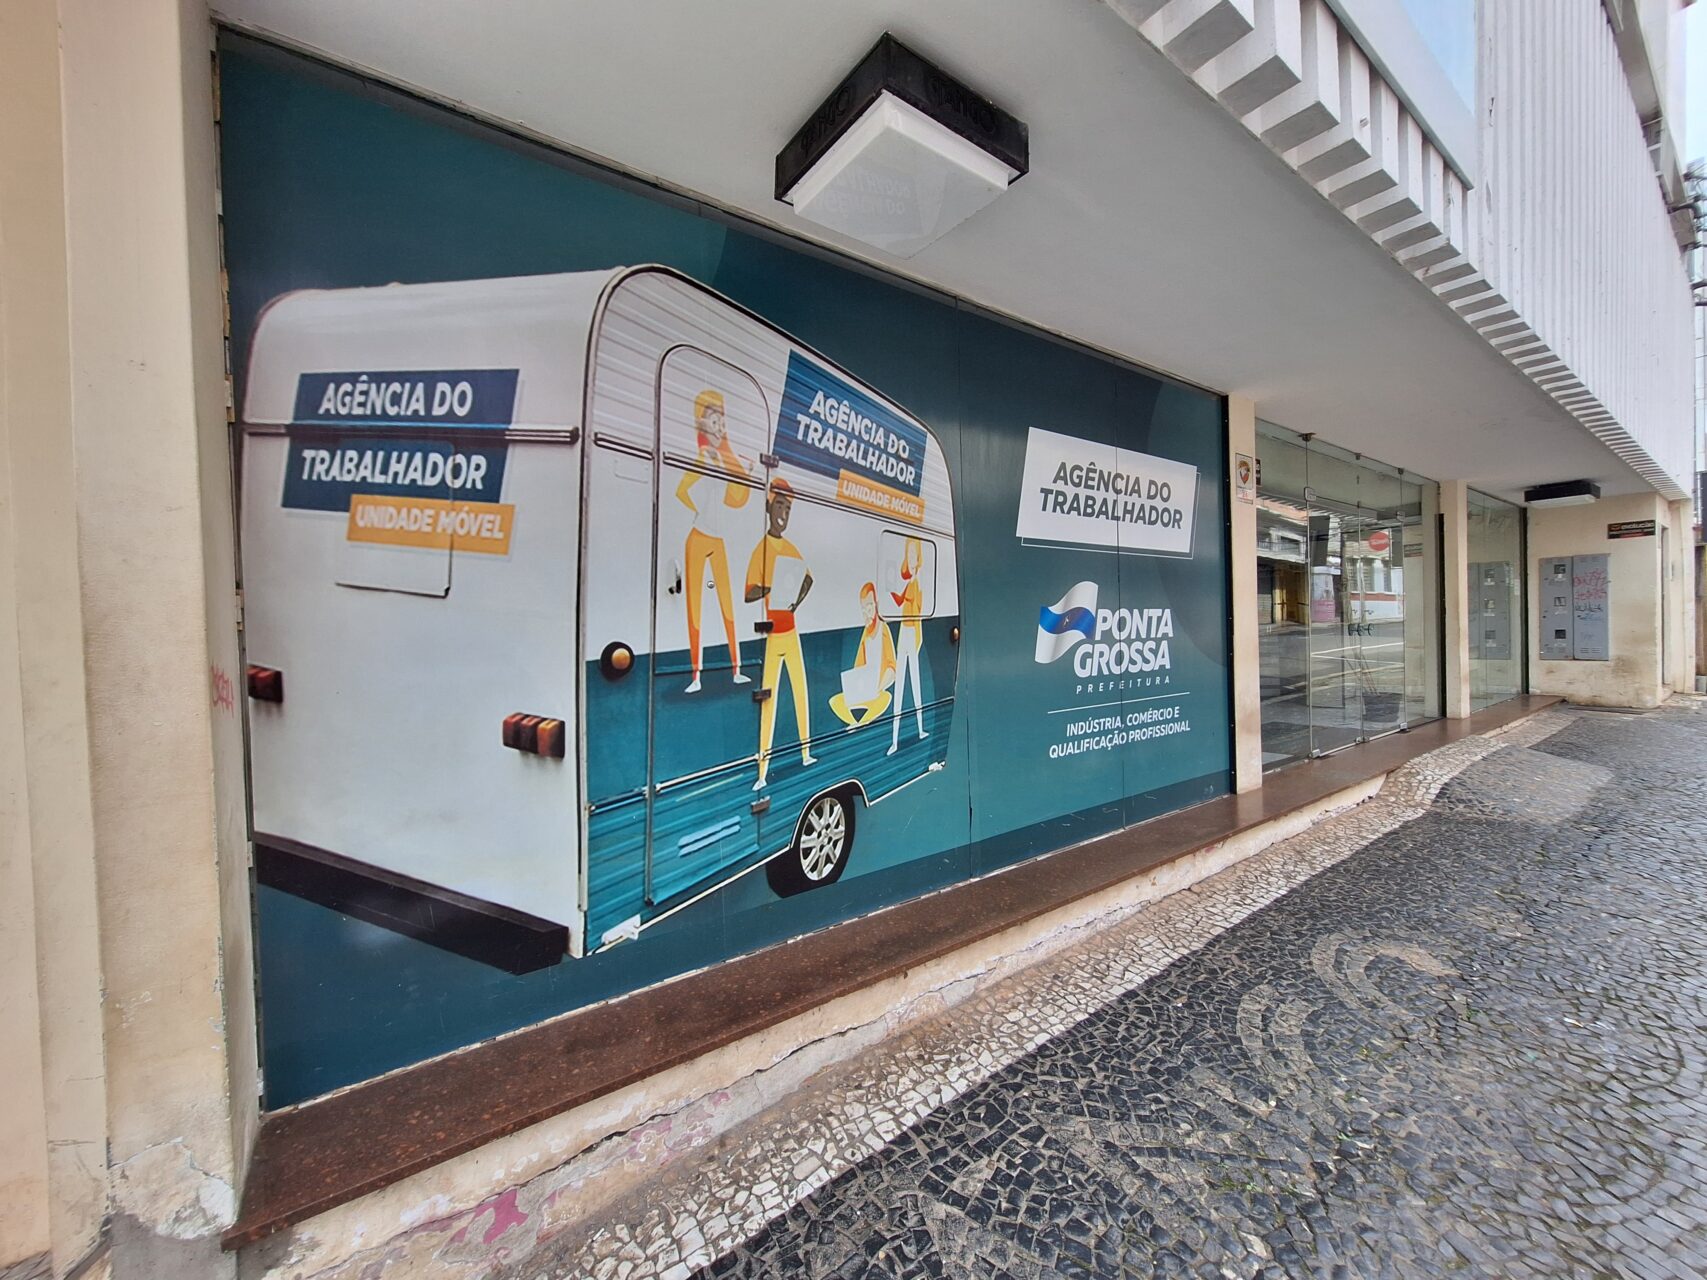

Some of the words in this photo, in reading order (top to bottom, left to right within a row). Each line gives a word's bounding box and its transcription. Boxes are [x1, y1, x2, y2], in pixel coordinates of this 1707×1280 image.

[318, 375, 426, 416] AGÊNCIA
[432, 381, 473, 416] DO
[809, 390, 885, 449] AGÊNCIA
[888, 433, 909, 459] DO
[797, 413, 915, 486] TRABALHADOR
[301, 450, 487, 490] TRABALHADOR
[1053, 461, 1142, 498] AGÊNCIA
[1147, 480, 1171, 503] DO
[843, 480, 890, 509] UNIDADE
[891, 495, 921, 517] MÓVEL
[1040, 487, 1183, 529] TRABALHADOR
[355, 504, 433, 532] UNIDADE
[436, 506, 504, 539] MÓVEL
[1095, 608, 1174, 640] PONTA
[1073, 640, 1171, 678] GROSSA
[1076, 675, 1170, 694] PREFEITURA
[1049, 732, 1127, 759] QUALIFICAÇÃO
[1128, 720, 1191, 743] PROFISSIONAL
[1066, 712, 1125, 736] INDÚSTRIA,
[1126, 707, 1173, 727] COMÉRCIO
[1174, 706, 1180, 718] E
